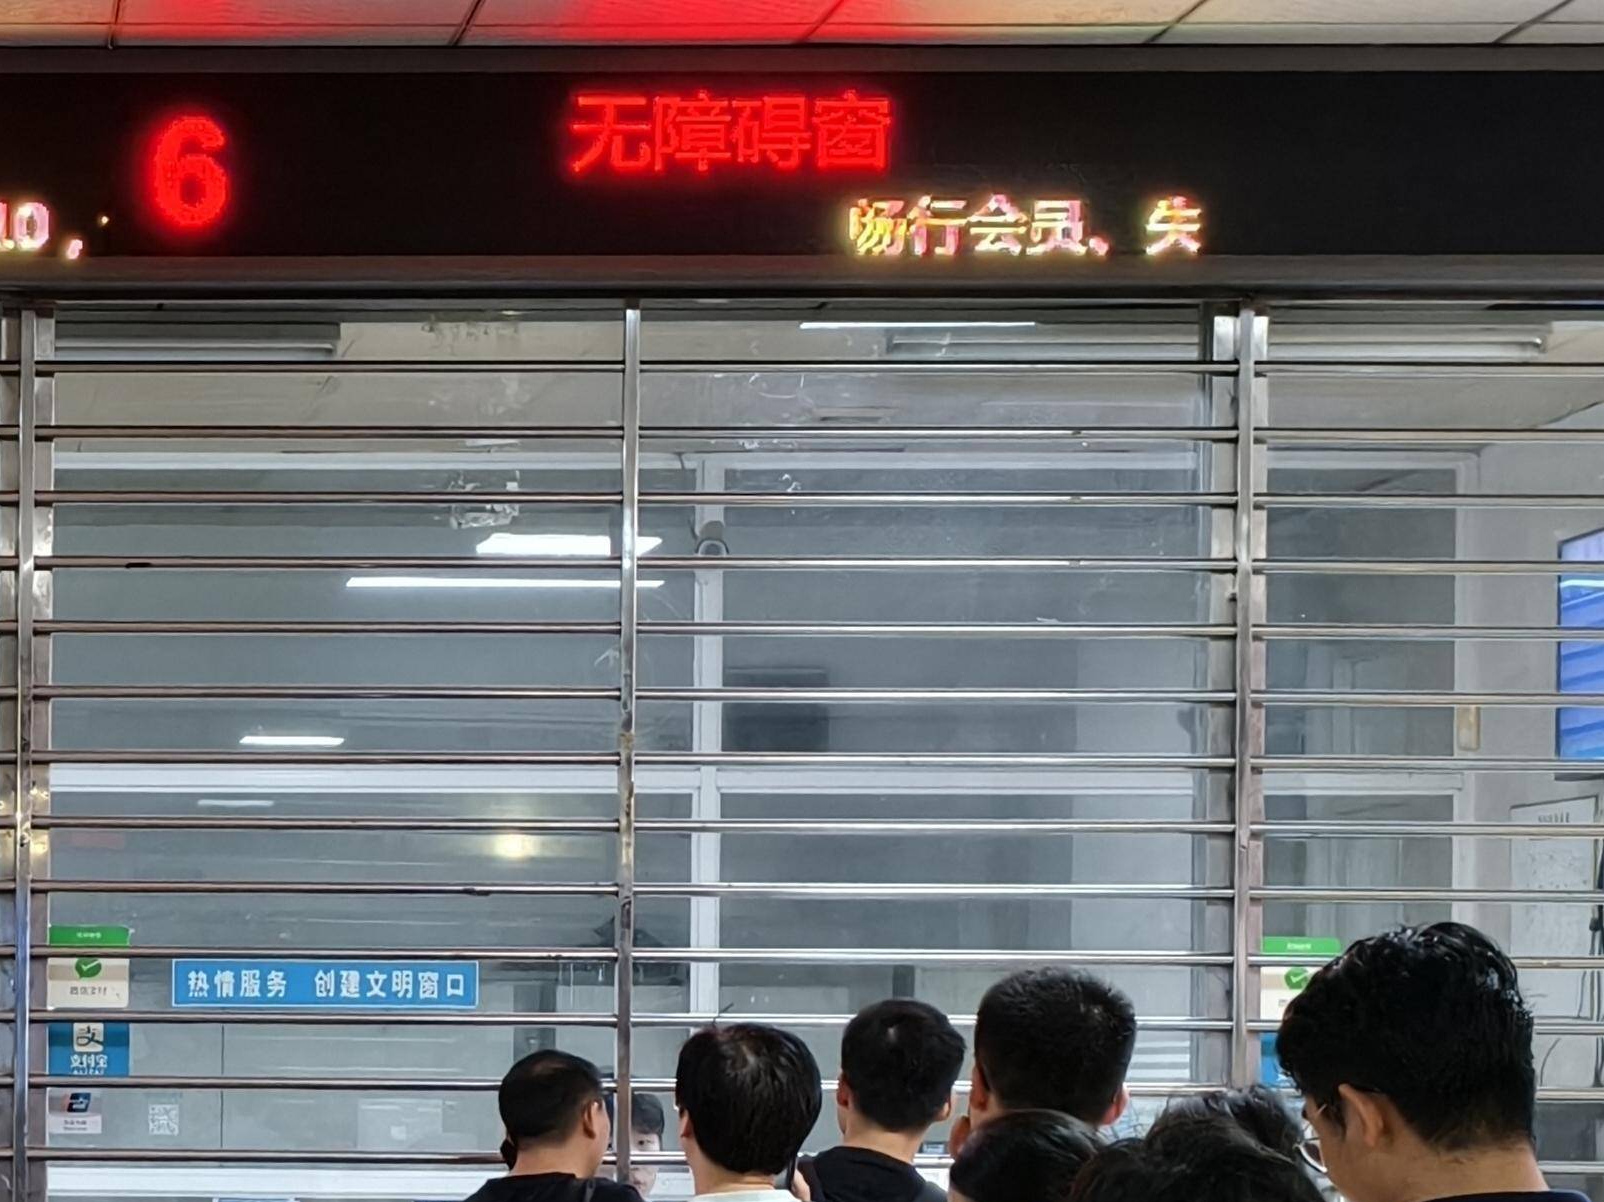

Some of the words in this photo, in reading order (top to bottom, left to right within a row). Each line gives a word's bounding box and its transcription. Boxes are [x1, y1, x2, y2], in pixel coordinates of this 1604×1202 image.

[151, 113, 229, 227] 6
[570, 88, 892, 174] 无障碍窗
[187, 968, 287, 999] 热情服务
[314, 968, 465, 1000] 创建文明窗口
